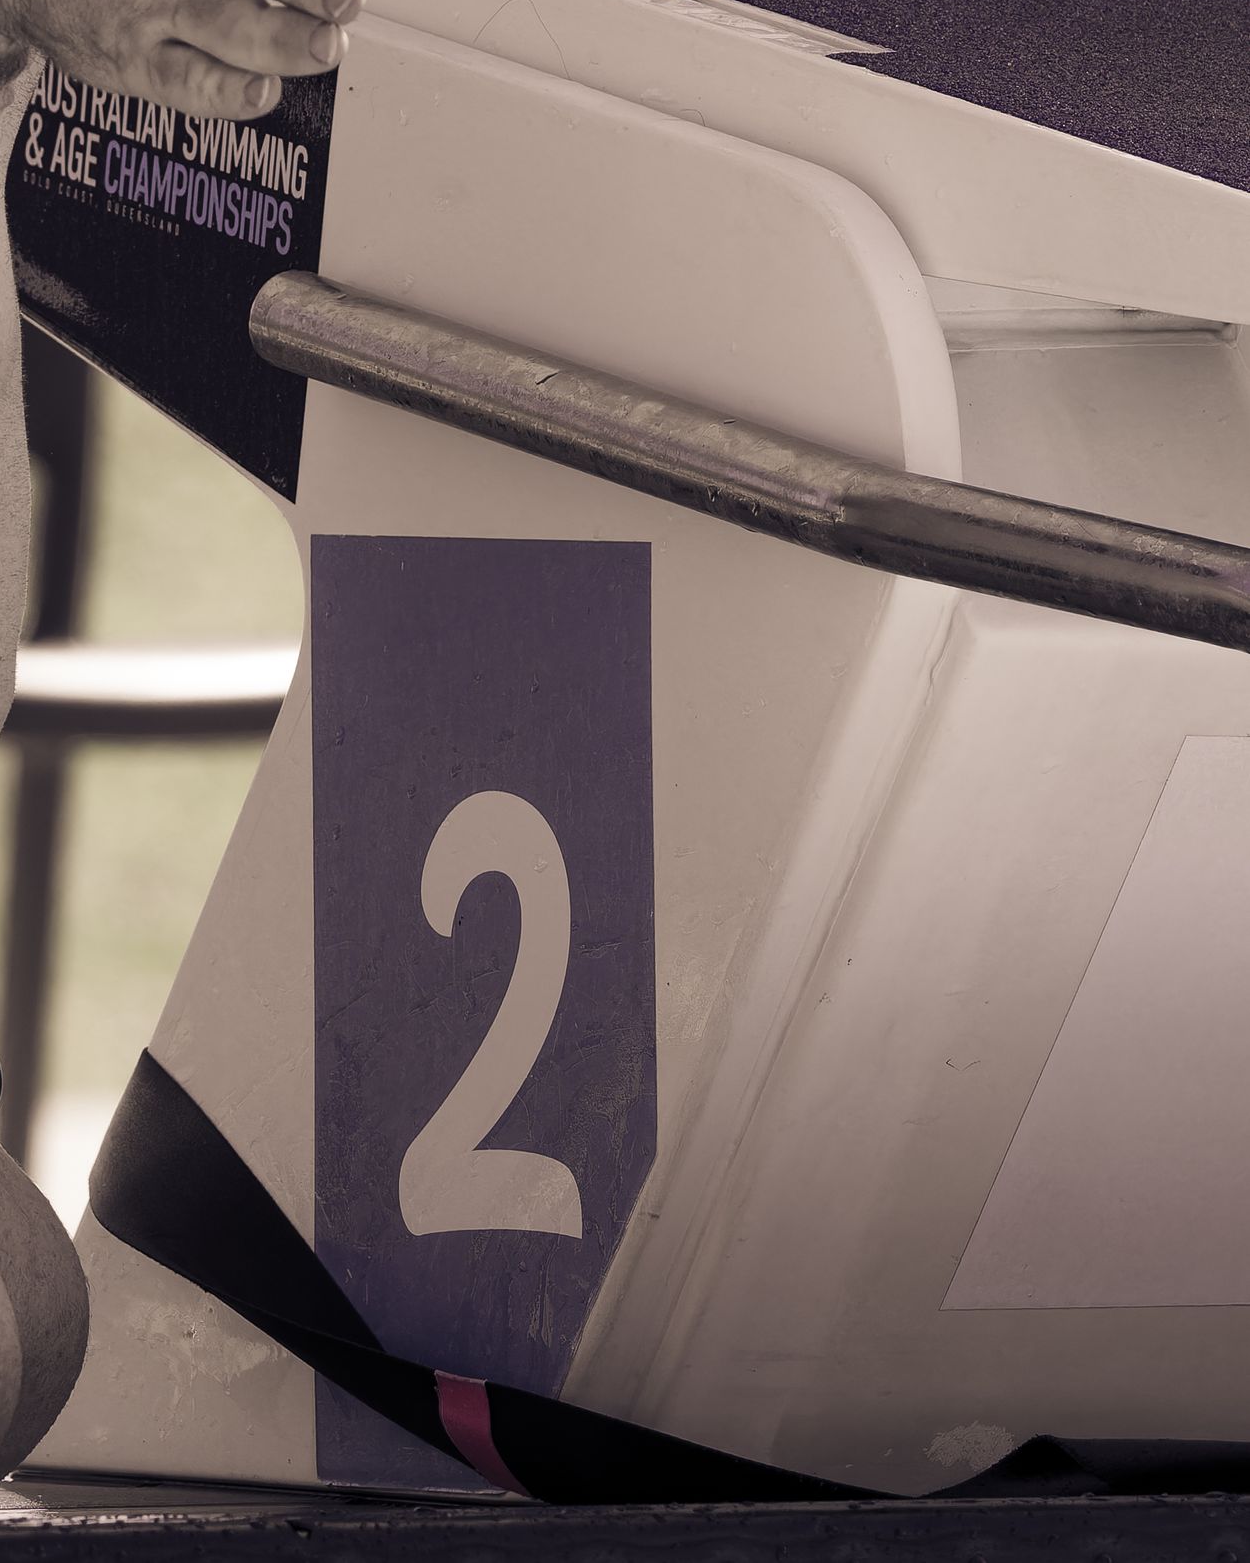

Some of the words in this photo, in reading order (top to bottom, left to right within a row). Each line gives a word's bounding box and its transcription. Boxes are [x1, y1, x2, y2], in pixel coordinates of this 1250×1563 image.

[25, 112, 45, 168] &
[50, 122, 101, 187] AGE
[104, 139, 293, 256] CHAMPIONSHIPS
[31, 60, 176, 154] AUSTRALIAN
[182, 113, 309, 201] SWIMMING
[23, 169, 51, 190] GOLD
[106, 198, 181, 237] QUEENSLAND
[398, 790, 582, 1238] 2
